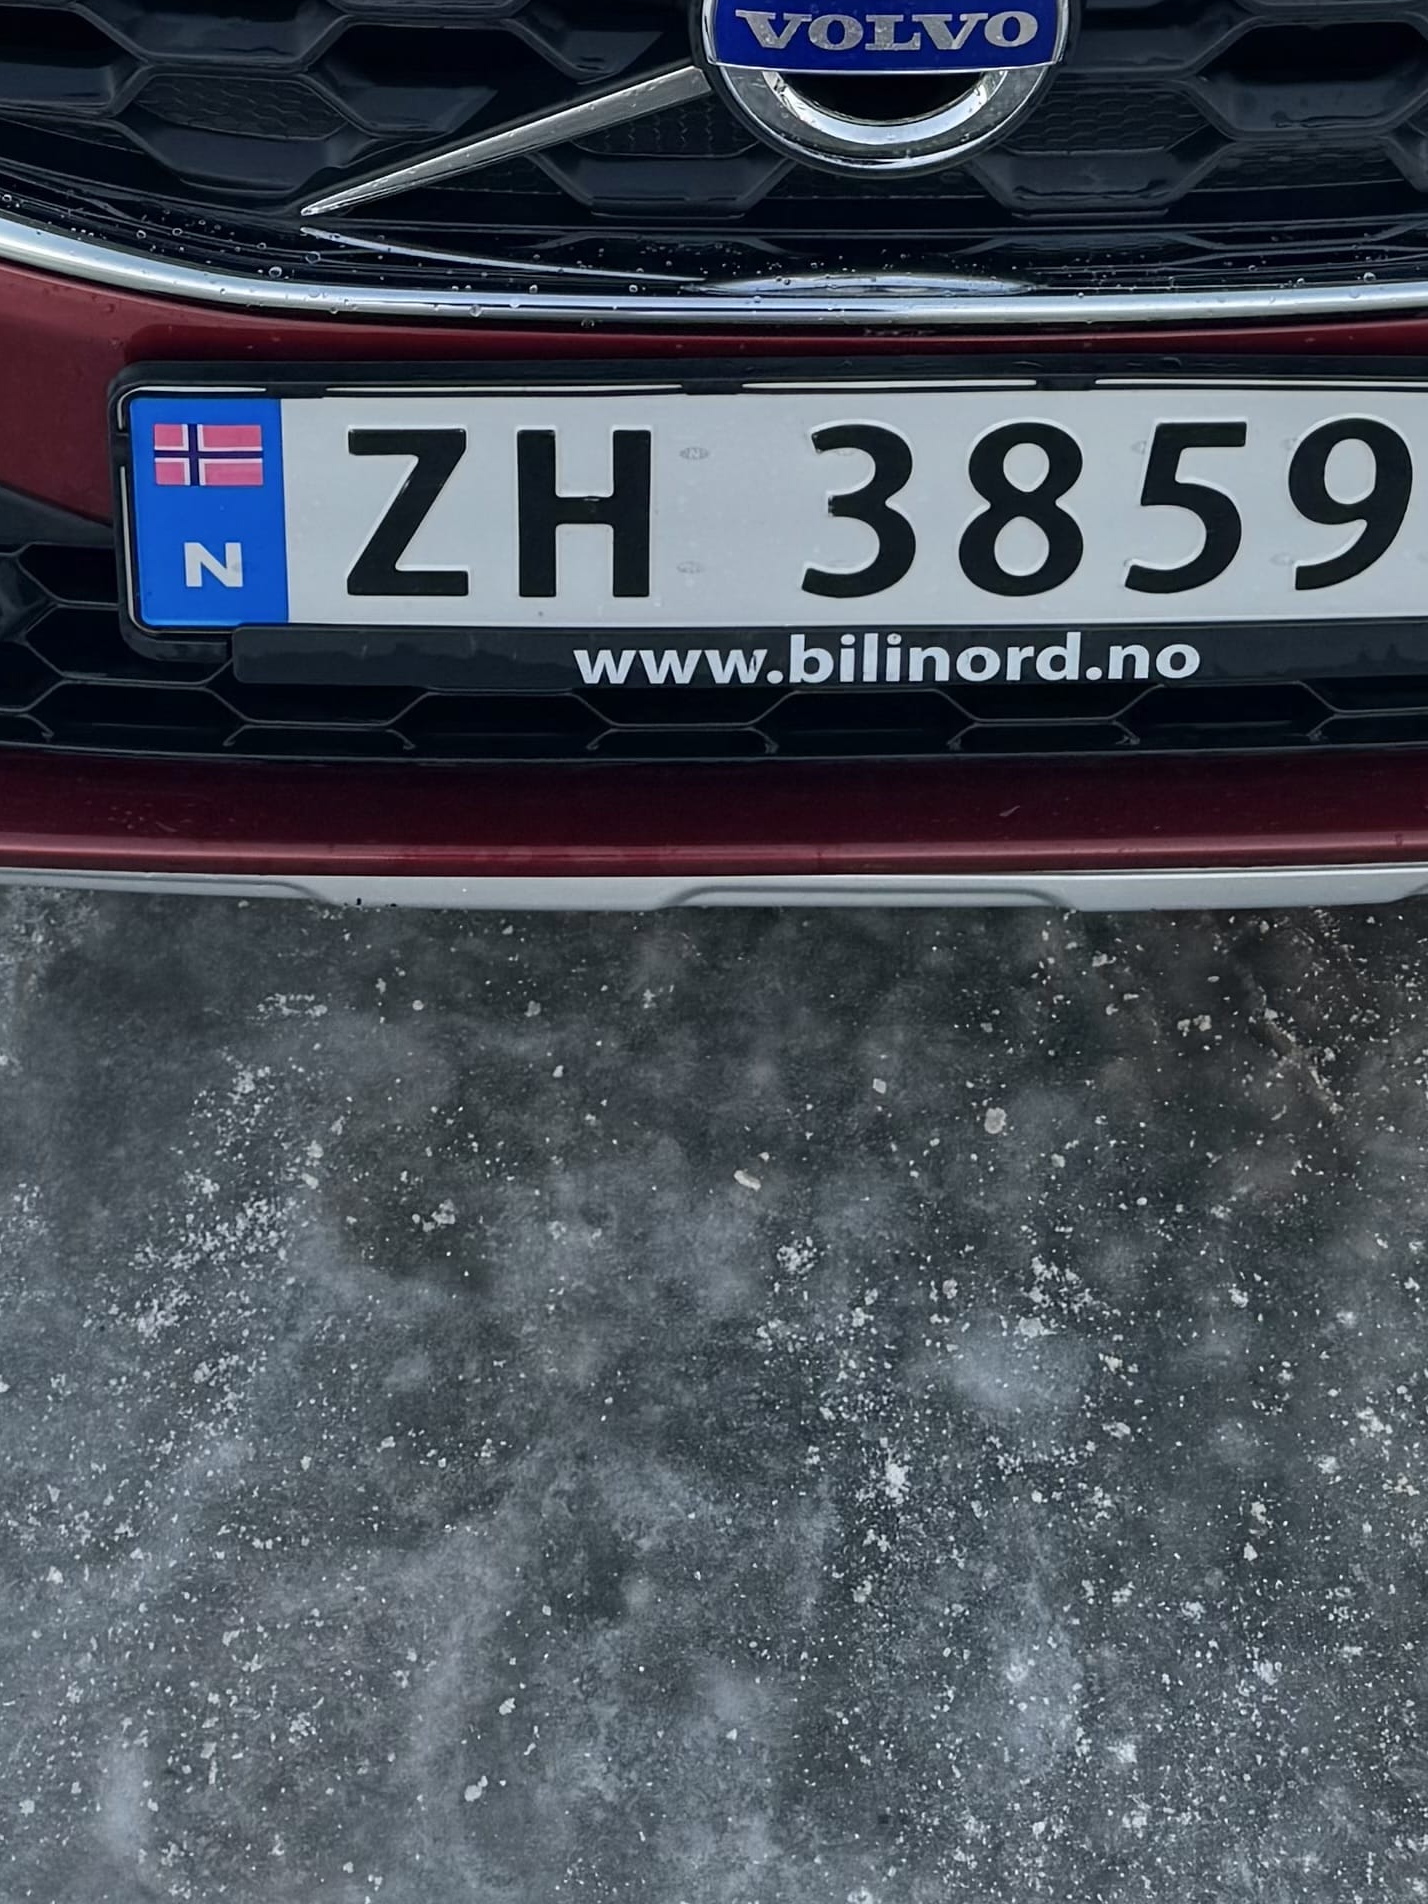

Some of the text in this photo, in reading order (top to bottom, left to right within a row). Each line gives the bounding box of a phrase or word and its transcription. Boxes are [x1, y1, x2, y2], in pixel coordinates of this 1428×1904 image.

[735, 9, 1038, 51] VOLVO
[346, 426, 650, 597] ZH
[184, 542, 244, 588] N
[572, 631, 1201, 685] www.bilinord.no
